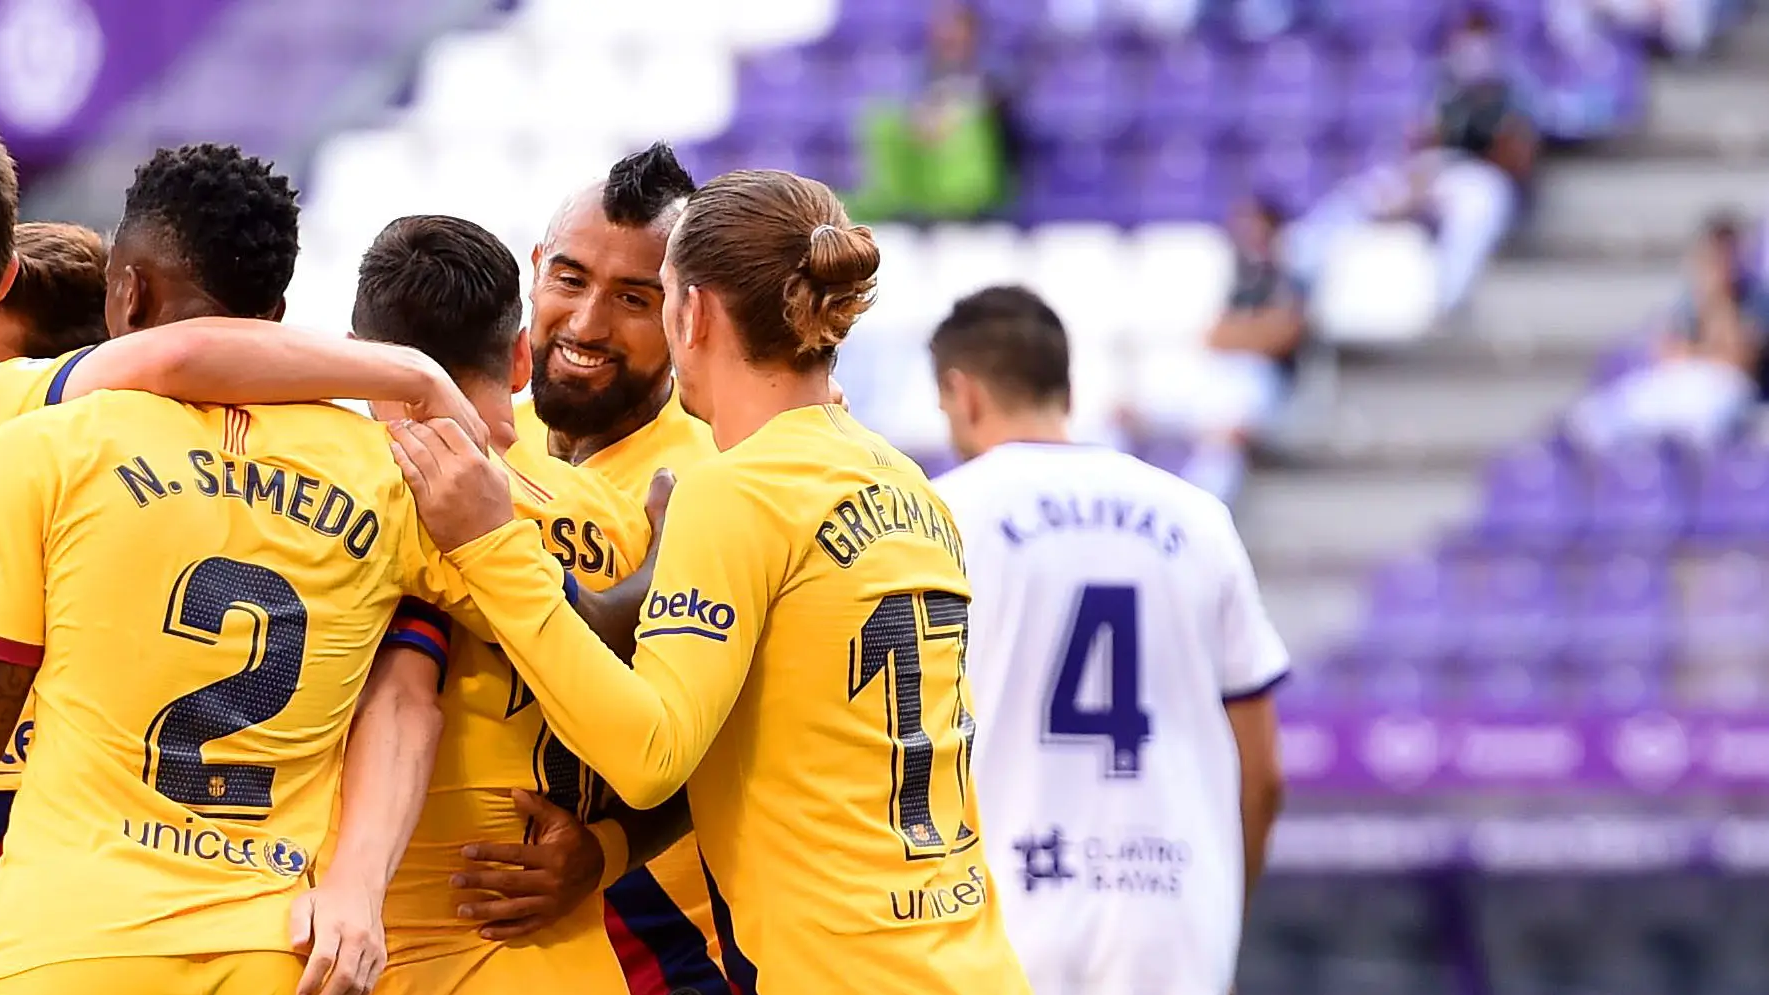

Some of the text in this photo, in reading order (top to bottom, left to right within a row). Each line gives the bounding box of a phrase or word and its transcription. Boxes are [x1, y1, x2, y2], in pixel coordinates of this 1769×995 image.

[114, 449, 380, 560] N. SEMEDO
[535, 516, 616, 579] SSI
[815, 483, 967, 579] GRIEZMAN
[646, 586, 736, 631] beko
[142, 555, 308, 822] 2
[847, 589, 980, 862] 17
[1038, 582, 1152, 780] 4
[890, 865, 988, 920] unicef
